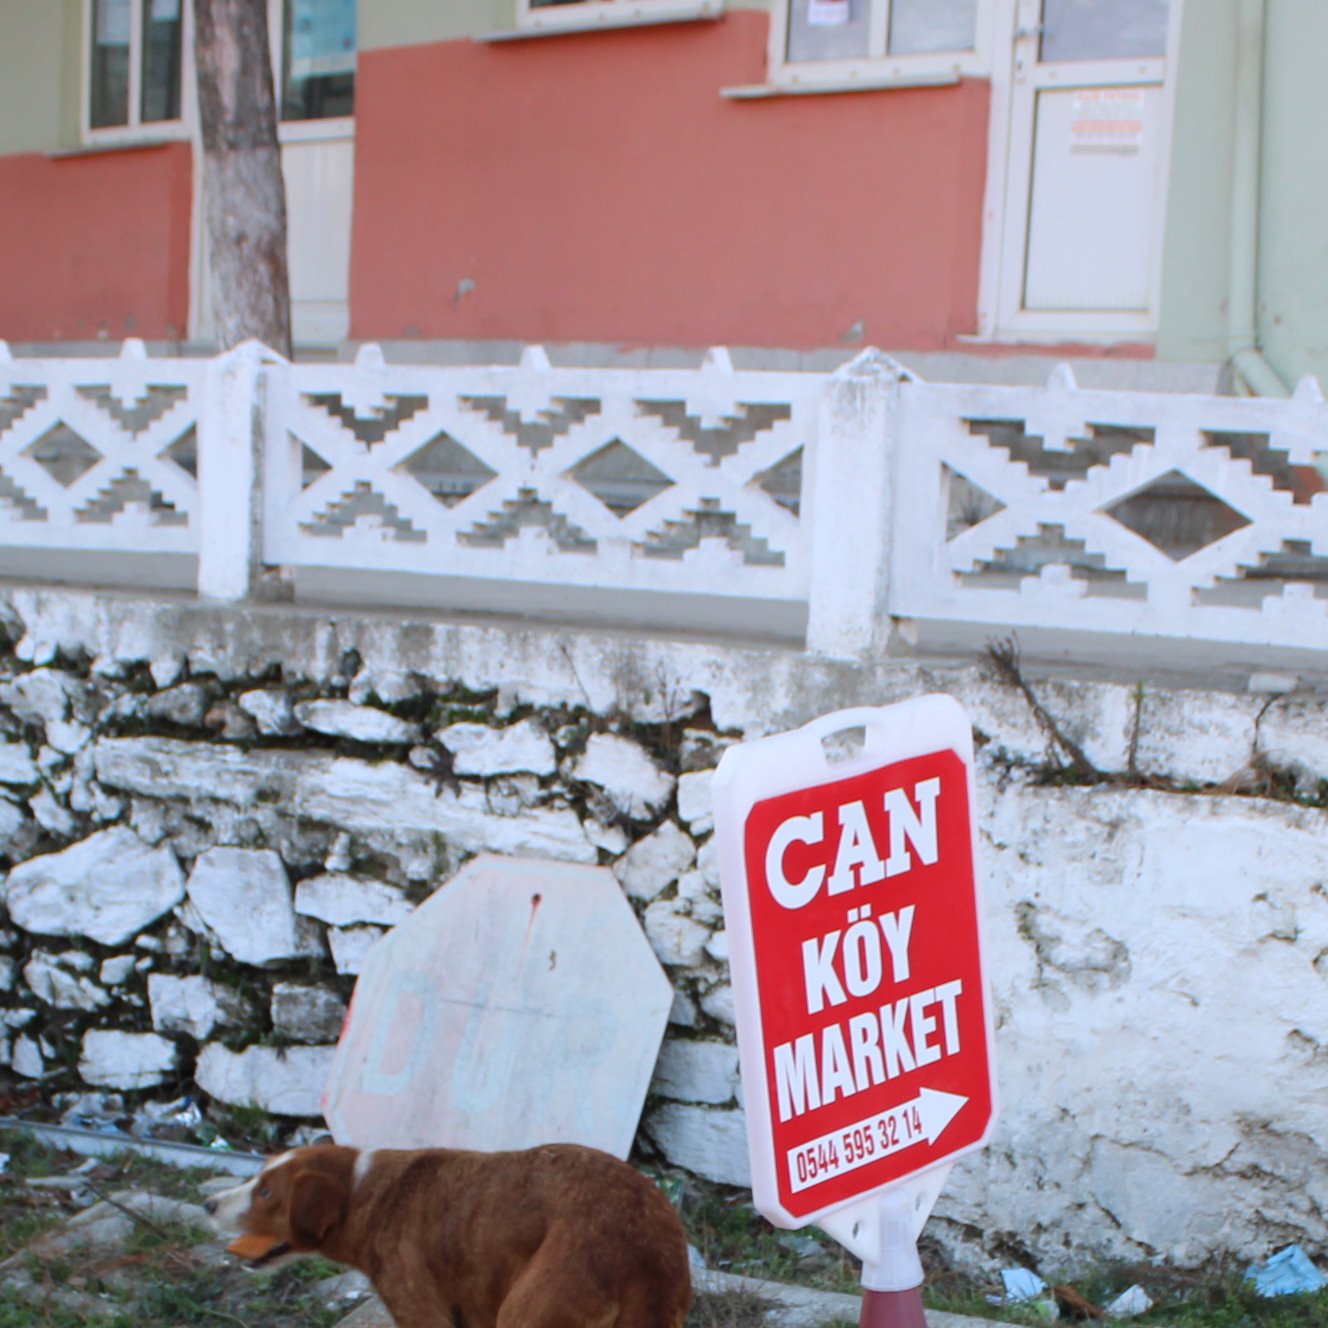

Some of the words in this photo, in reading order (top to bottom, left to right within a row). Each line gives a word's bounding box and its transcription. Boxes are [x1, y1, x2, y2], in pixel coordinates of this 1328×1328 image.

[765, 776, 940, 909] CAN
[801, 903, 916, 1016] KÖY
[362, 970, 618, 1131] DUR
[773, 979, 962, 1123] MARKET
[796, 1140, 839, 1183] 0544
[842, 1125, 874, 1163] 595
[877, 1115, 900, 1149] 32
[902, 1106, 922, 1139] 14
